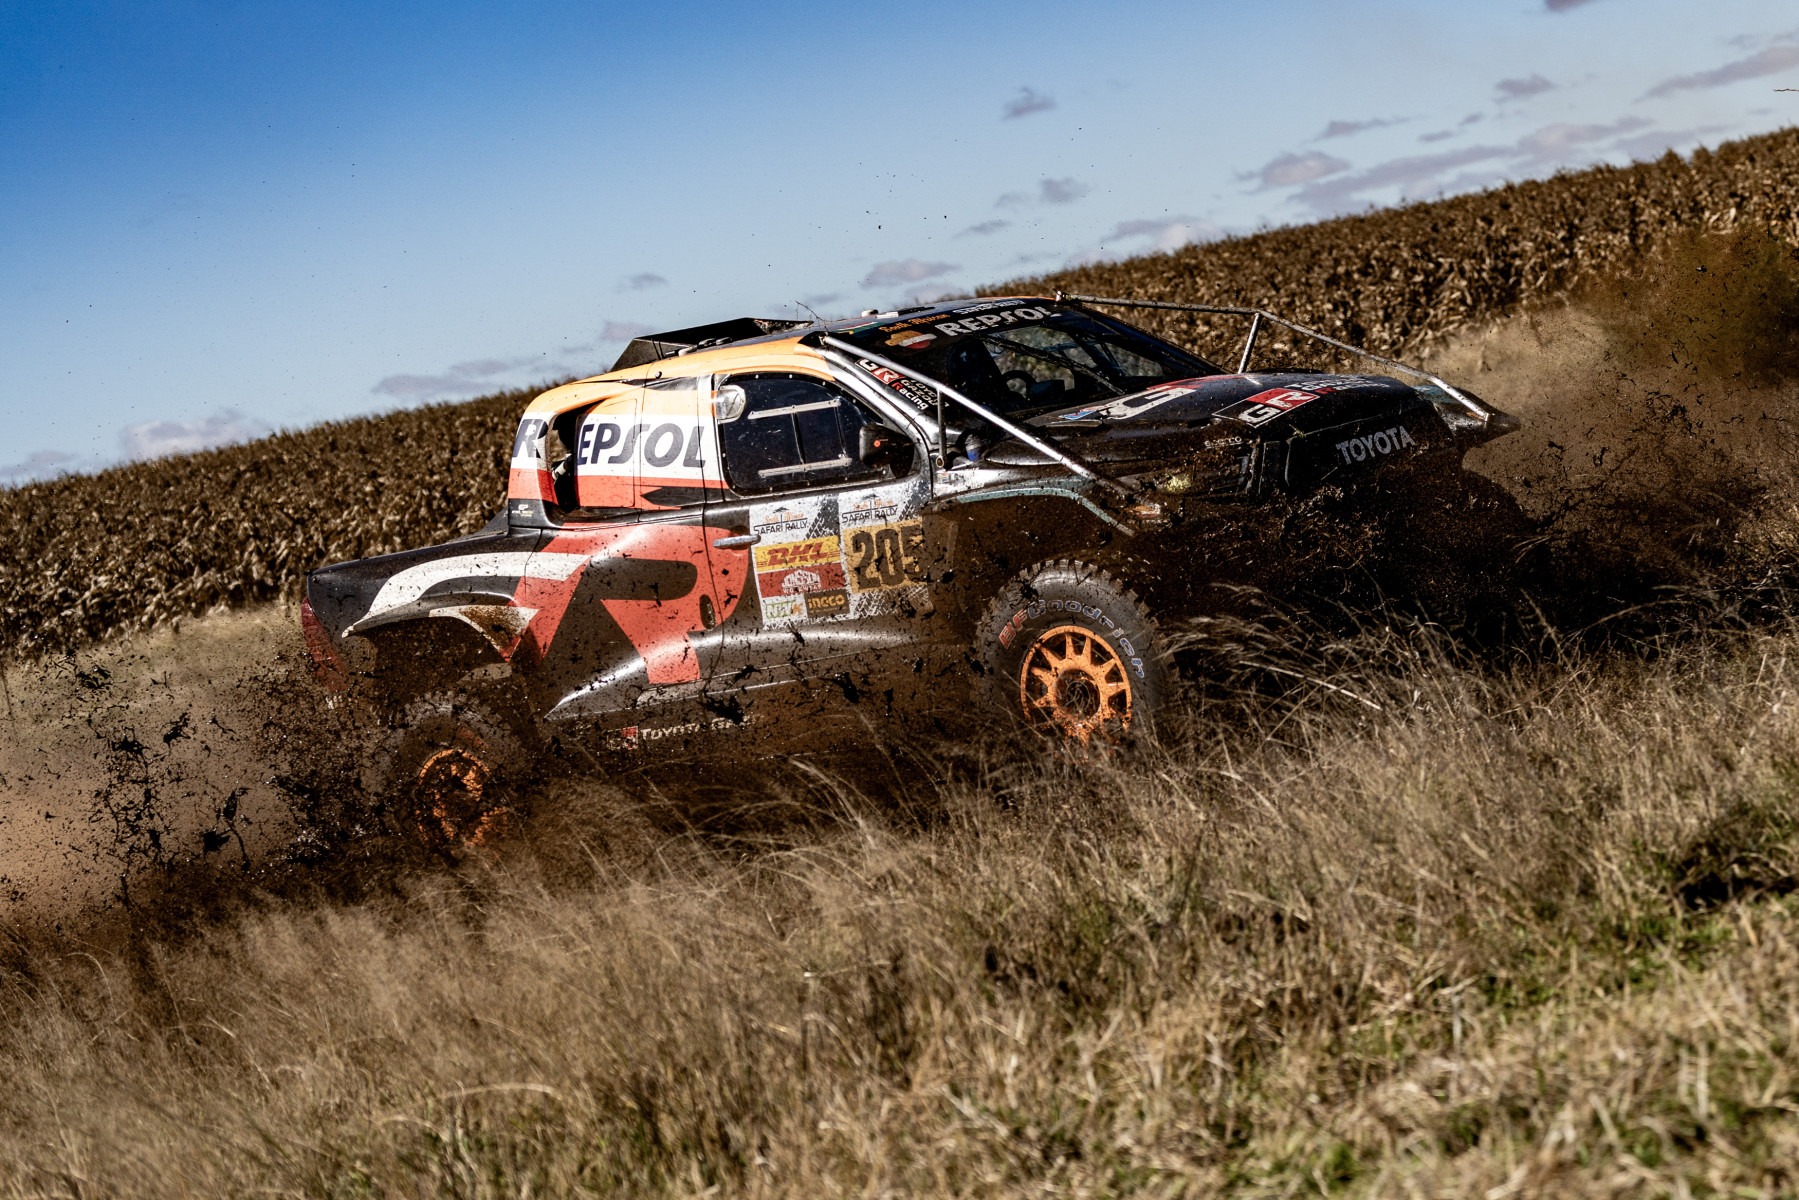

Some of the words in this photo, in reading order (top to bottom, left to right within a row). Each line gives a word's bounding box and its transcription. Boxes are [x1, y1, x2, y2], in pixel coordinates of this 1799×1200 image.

[935, 306, 1051, 337] REPSOL
[891, 382, 929, 411] Racing
[1238, 391, 1317, 424] GR
[512, 418, 707, 468] REPSOL
[1335, 425, 1416, 465] TOYOTA
[753, 521, 784, 536] SAFARI
[785, 519, 808, 532] RALLY
[841, 509, 873, 524] SAFARI
[874, 505, 898, 520] RALLY
[766, 541, 829, 567] DHL
[851, 523, 924, 590] 205
